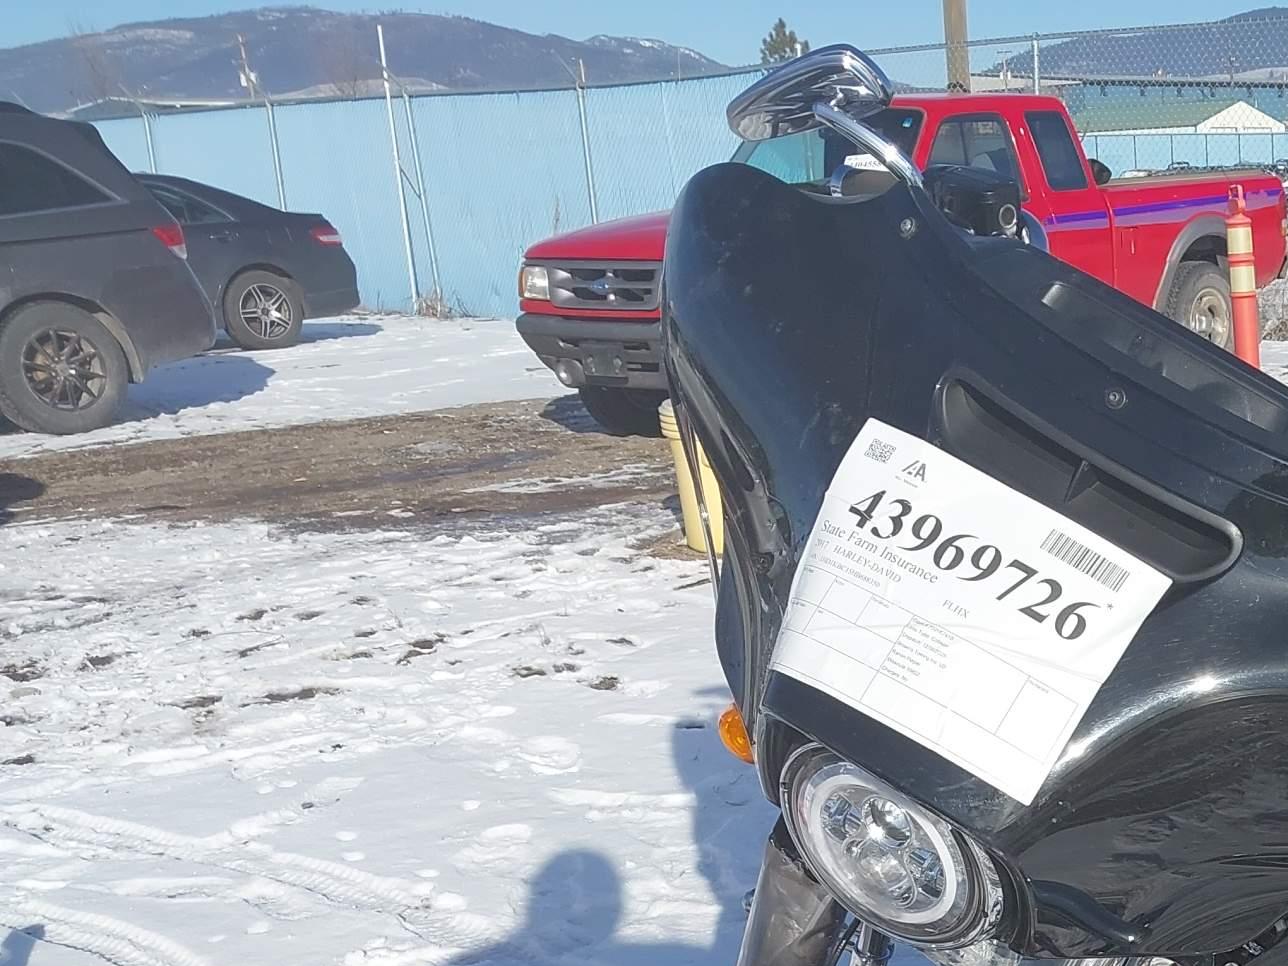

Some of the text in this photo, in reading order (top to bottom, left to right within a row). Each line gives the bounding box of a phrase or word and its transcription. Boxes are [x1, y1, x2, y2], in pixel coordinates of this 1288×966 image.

[820, 519, 938, 584] State Farm Insurance
[833, 544, 902, 583] HARLEY-DAVID
[848, 490, 1102, 640] 43969726
